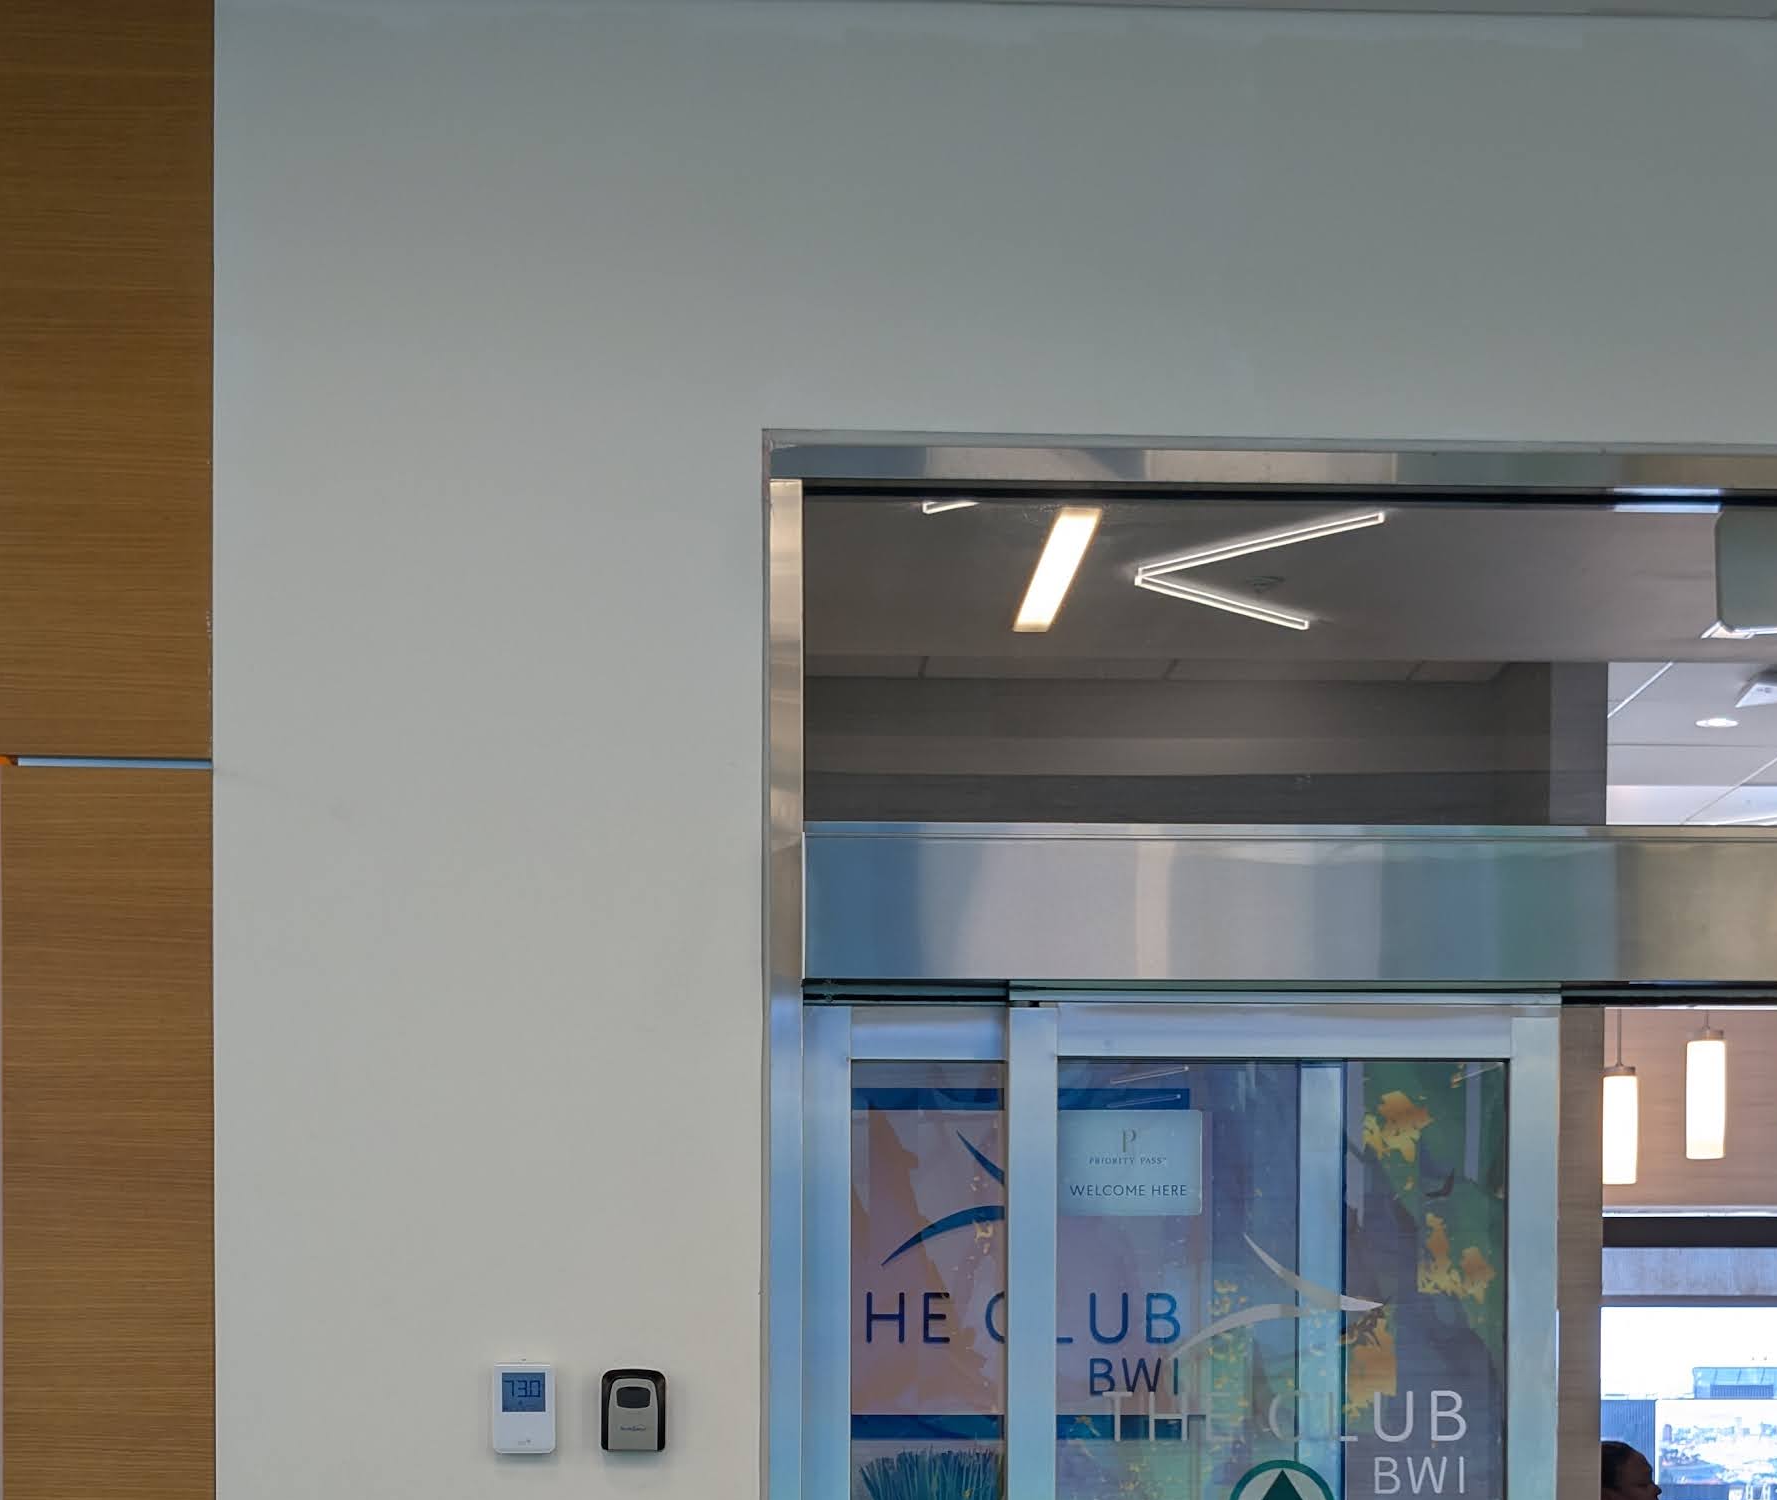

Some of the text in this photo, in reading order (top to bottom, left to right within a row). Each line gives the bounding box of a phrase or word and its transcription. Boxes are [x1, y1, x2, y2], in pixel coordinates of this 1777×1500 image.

[1089, 1156, 1135, 1165] PRIORITY
[1069, 1184, 1188, 1197] WELCOME HERE
[865, 1291, 951, 1344] HE
[1088, 1357, 1180, 1396] BWI
[1102, 1390, 1232, 1443] THE
[1372, 1455, 1467, 1496] BWI
